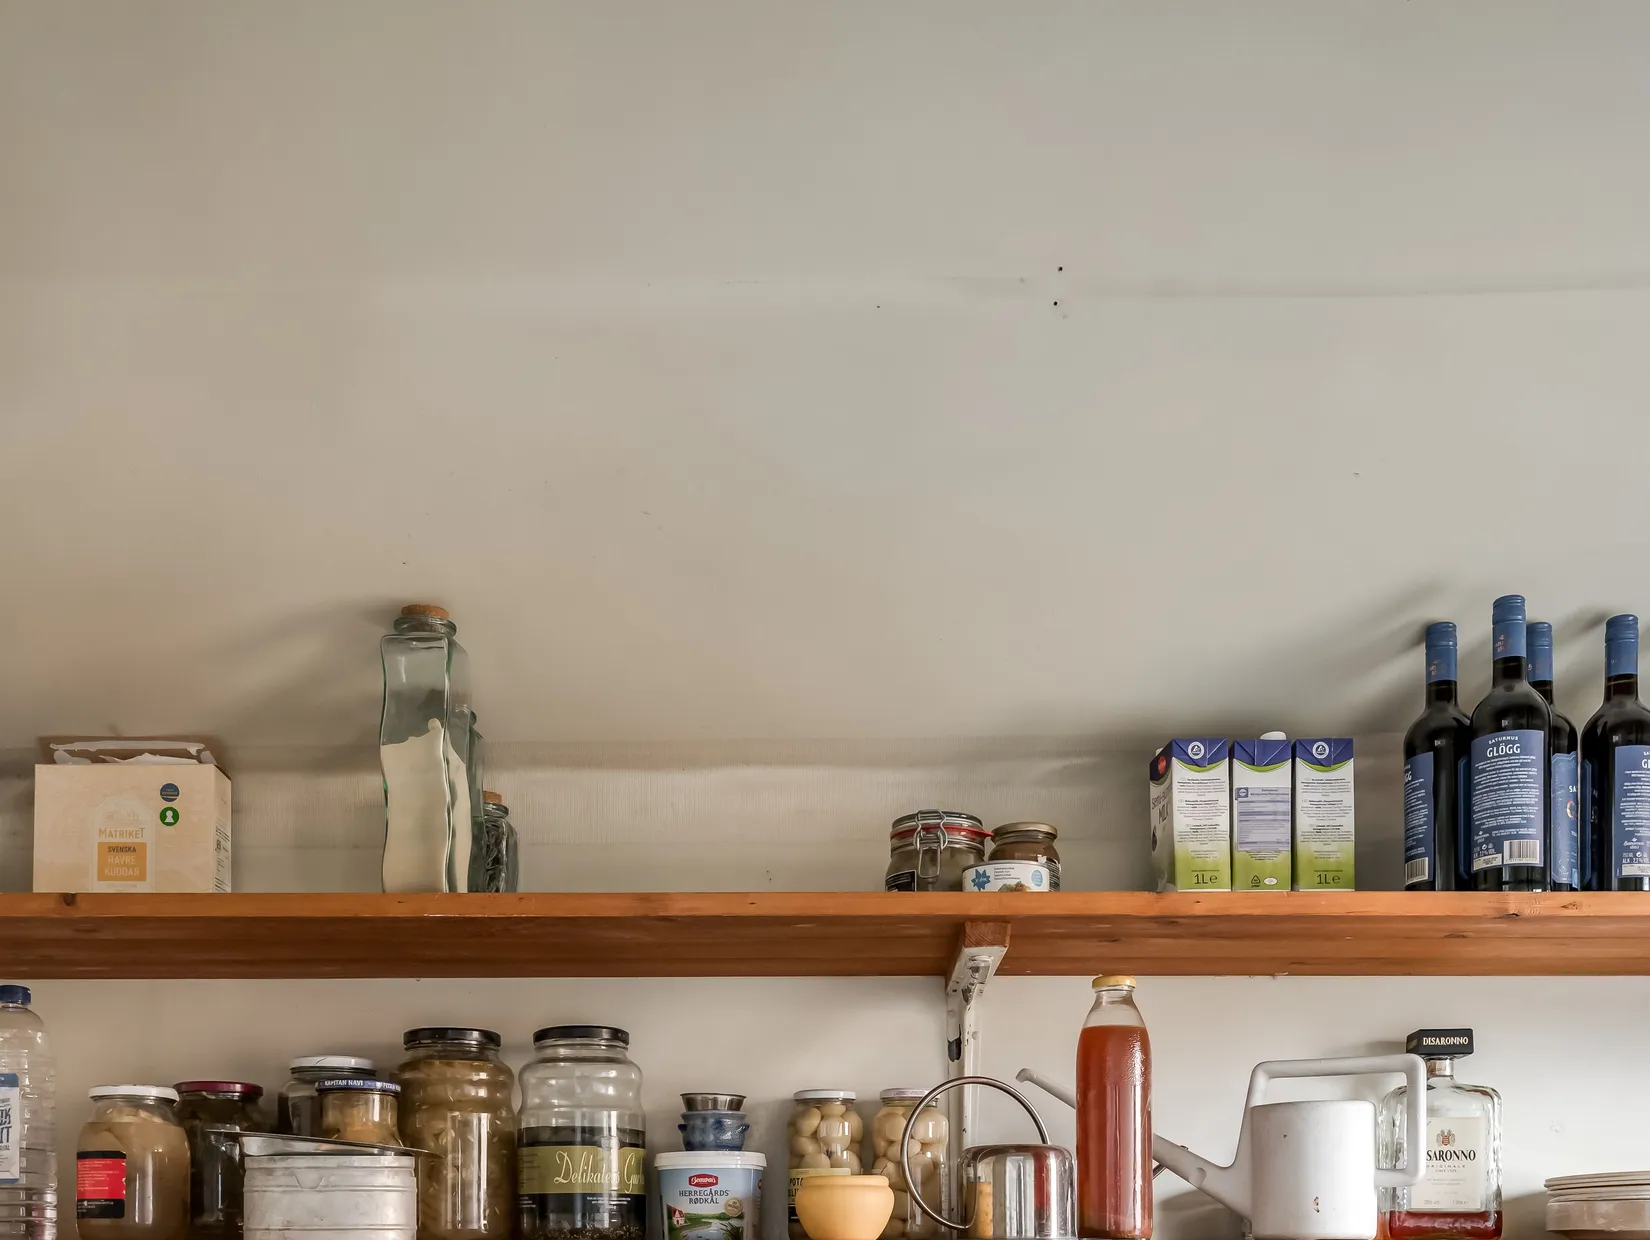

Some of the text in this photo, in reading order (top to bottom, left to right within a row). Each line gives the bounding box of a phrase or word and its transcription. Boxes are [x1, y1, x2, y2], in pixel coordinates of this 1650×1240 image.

[1488, 735, 1519, 745] SATURNUS
[1486, 743, 1521, 758] GLÖGG
[98, 827, 146, 839] MATRIKET
[107, 845, 137, 853] SVENSKA
[108, 855, 136, 865] HAVRE
[104, 866, 141, 877] KUDDAR
[1423, 1036, 1469, 1046] DISARONNO
[1426, 1149, 1477, 1162] SARONNO
